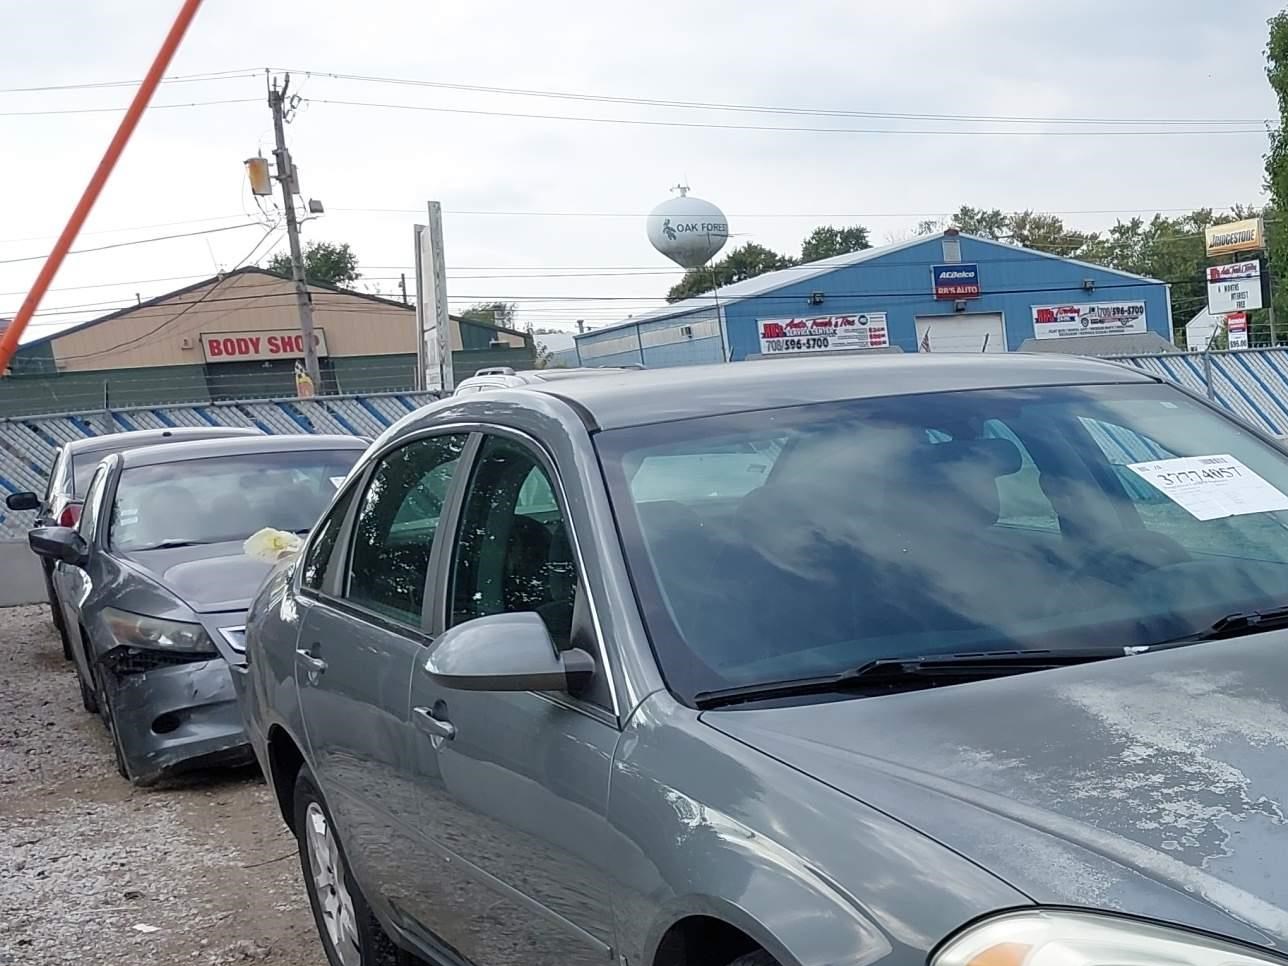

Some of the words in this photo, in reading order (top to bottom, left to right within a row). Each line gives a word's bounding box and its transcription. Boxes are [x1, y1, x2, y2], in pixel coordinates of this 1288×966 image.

[676, 223, 698, 233] OAK
[1208, 229, 1255, 248] BRIDGESTONE
[939, 271, 975, 279] ACDelco
[957, 286, 978, 294] AUTO
[208, 337, 261, 356] BODY
[1157, 466, 1243, 486] 37774057
